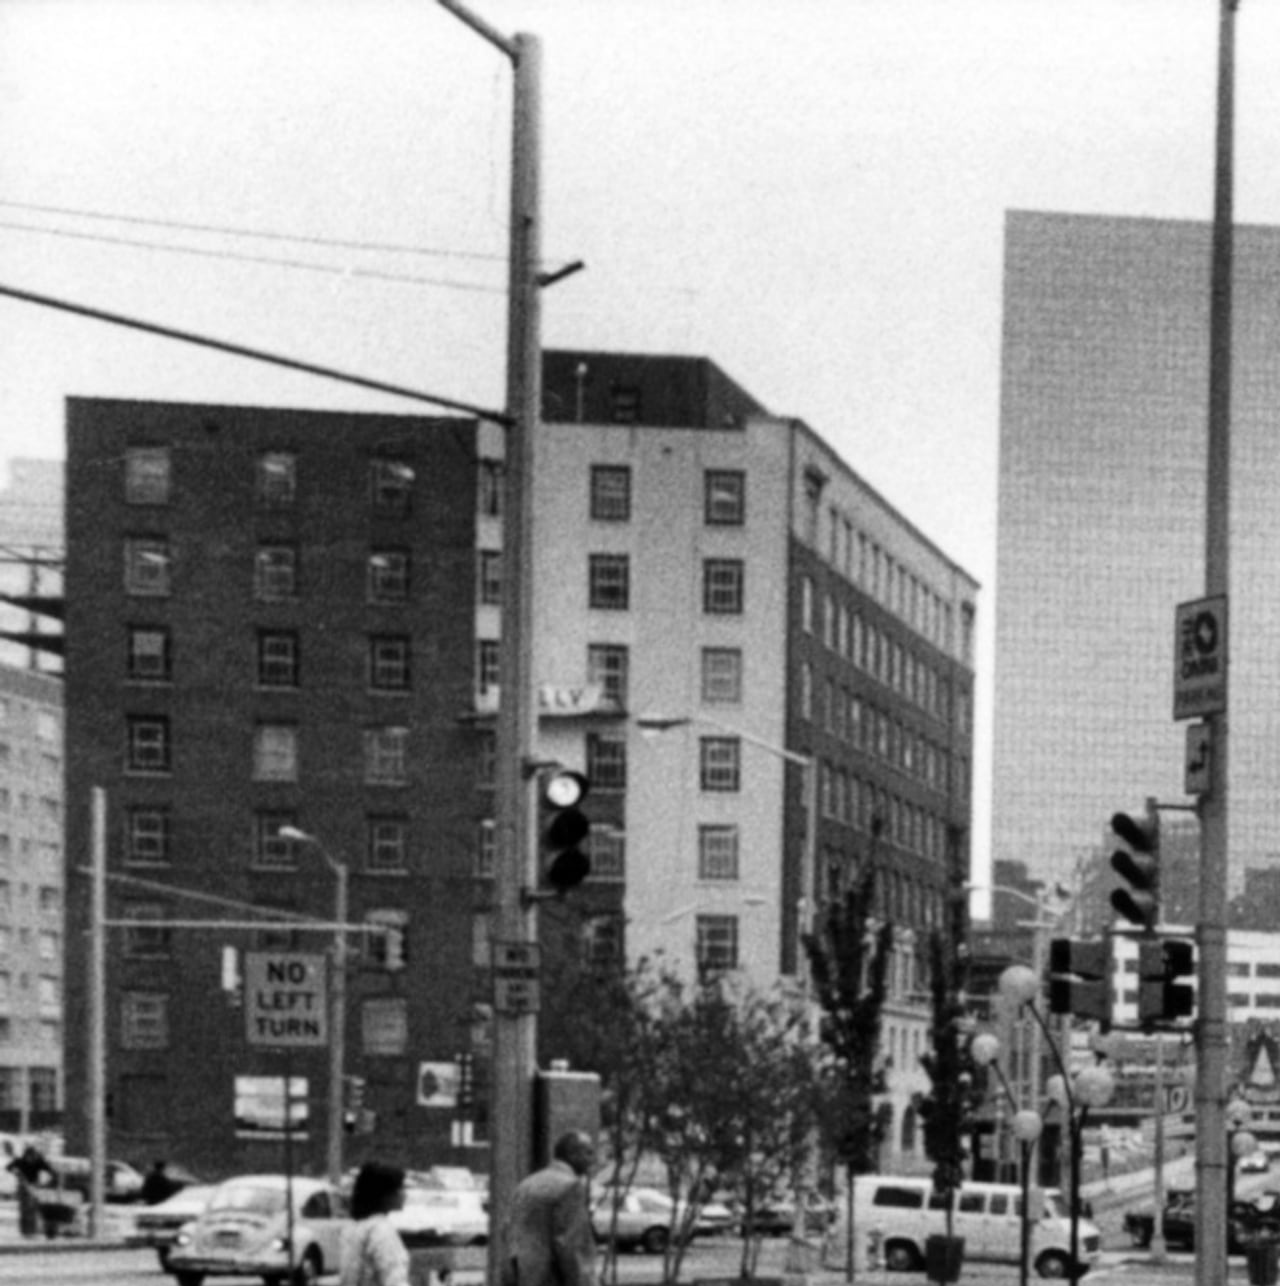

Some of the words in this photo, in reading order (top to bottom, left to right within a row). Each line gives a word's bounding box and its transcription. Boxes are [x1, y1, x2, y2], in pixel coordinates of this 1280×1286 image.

[267, 961, 306, 984] NO
[257, 991, 316, 1011] LEFT
[256, 1017, 319, 1037] TURN
